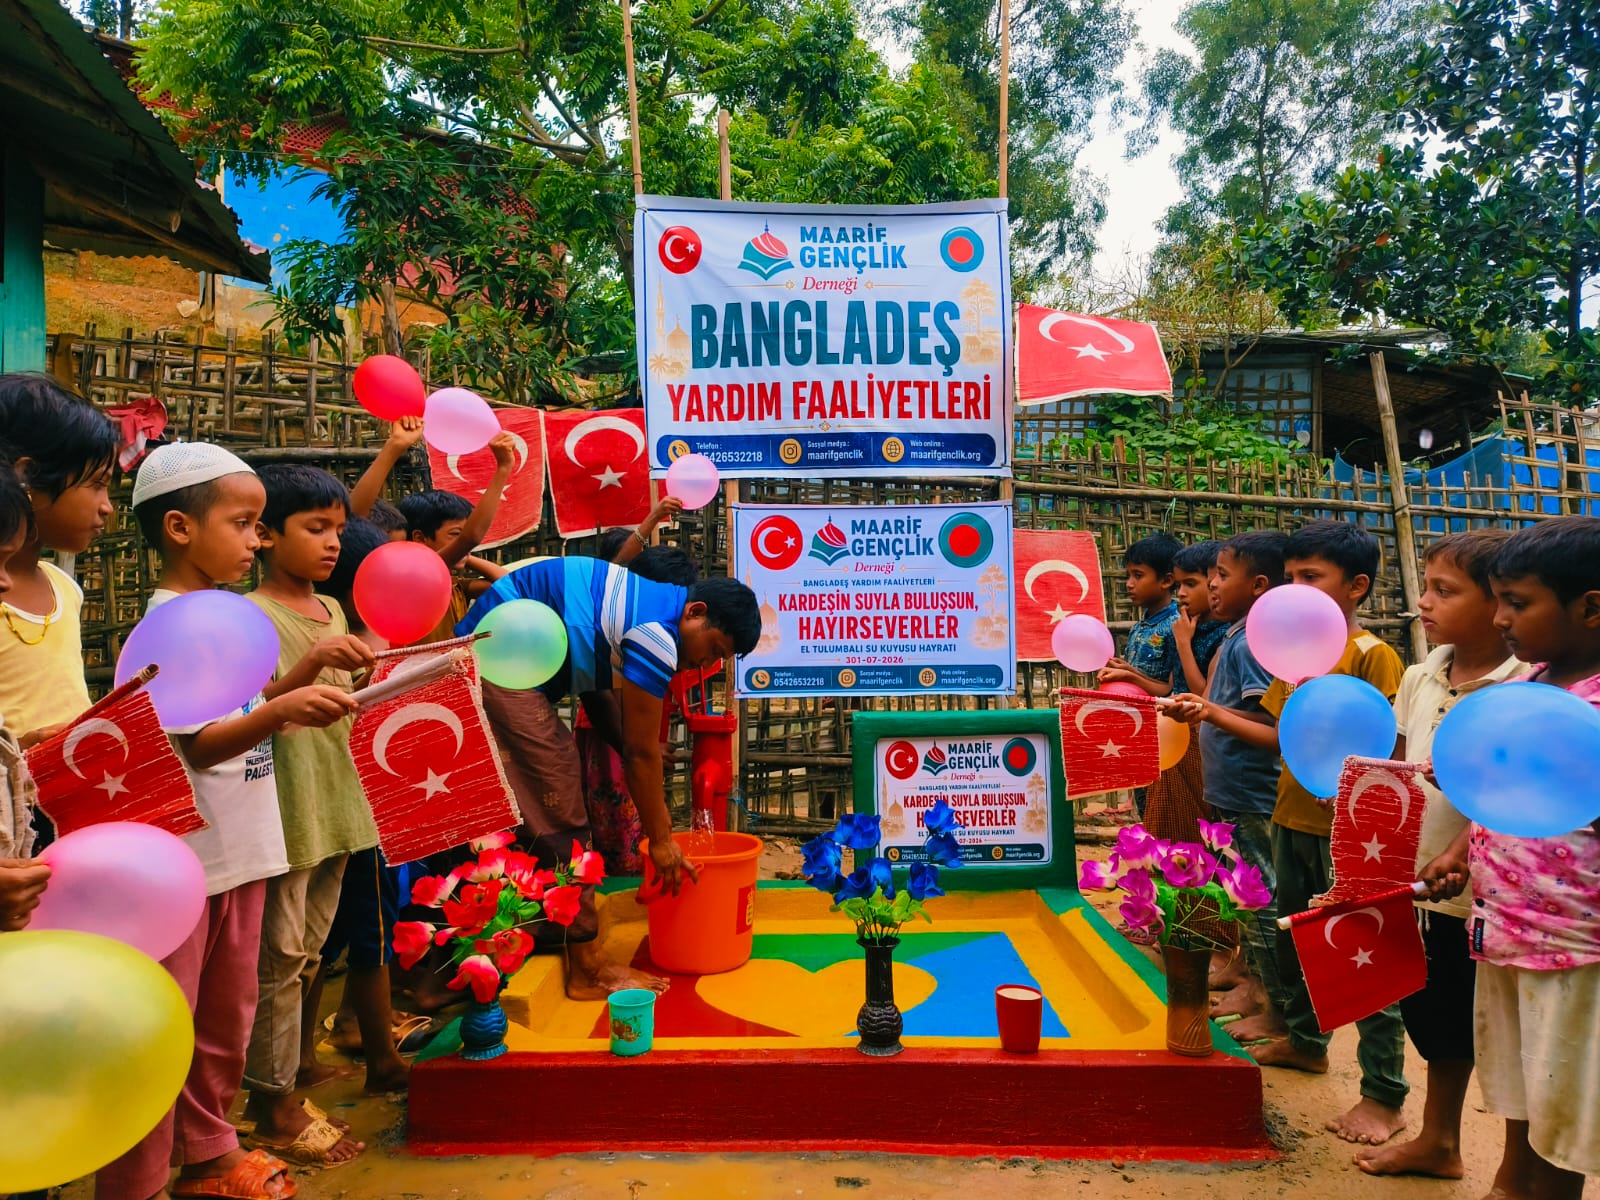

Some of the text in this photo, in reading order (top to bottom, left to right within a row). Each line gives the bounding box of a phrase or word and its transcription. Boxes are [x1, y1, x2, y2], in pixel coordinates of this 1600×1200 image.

[800, 222, 887, 243] MAARİF
[800, 242, 908, 274] GENÇLİK
[802, 276, 858, 294] Derneği
[691, 300, 961, 376] BANGLADEŞ
[666, 373, 991, 422] YARDIM FAALİYETLERİ
[808, 450, 864, 461] maarifgenclik
[911, 450, 981, 461] maarifgenclik.org
[851, 515, 922, 535] MAARİF
[852, 534, 934, 560] GENÇLİK
[855, 562, 895, 574] Derneği
[803, 577, 935, 588] BANGLADEŞ YARDIM FAALİYETLERİ
[779, 589, 979, 615] KARDEŞİN SUYLA BULUŞSUN,
[799, 615, 958, 640] HAYIRSEVERLER
[813, 645, 863, 653] TULUMBALI
[866, 645, 877, 653] SU
[880, 645, 916, 653] KUYUSU
[919, 644, 956, 652] HAYRATI
[846, 656, 903, 664] 301-07-2026
[774, 677, 824, 686] 05426532218
[860, 677, 903, 685] maarifgenclik
[948, 740, 992, 755] MAARİF
[948, 753, 1000, 772] GENÇLİK
[950, 773, 976, 781] Derneği
[951, 794, 980, 807] SUYLA
[982, 793, 1028, 809] BULUŞSUN,
[917, 810, 1016, 828] HSEVERLER
